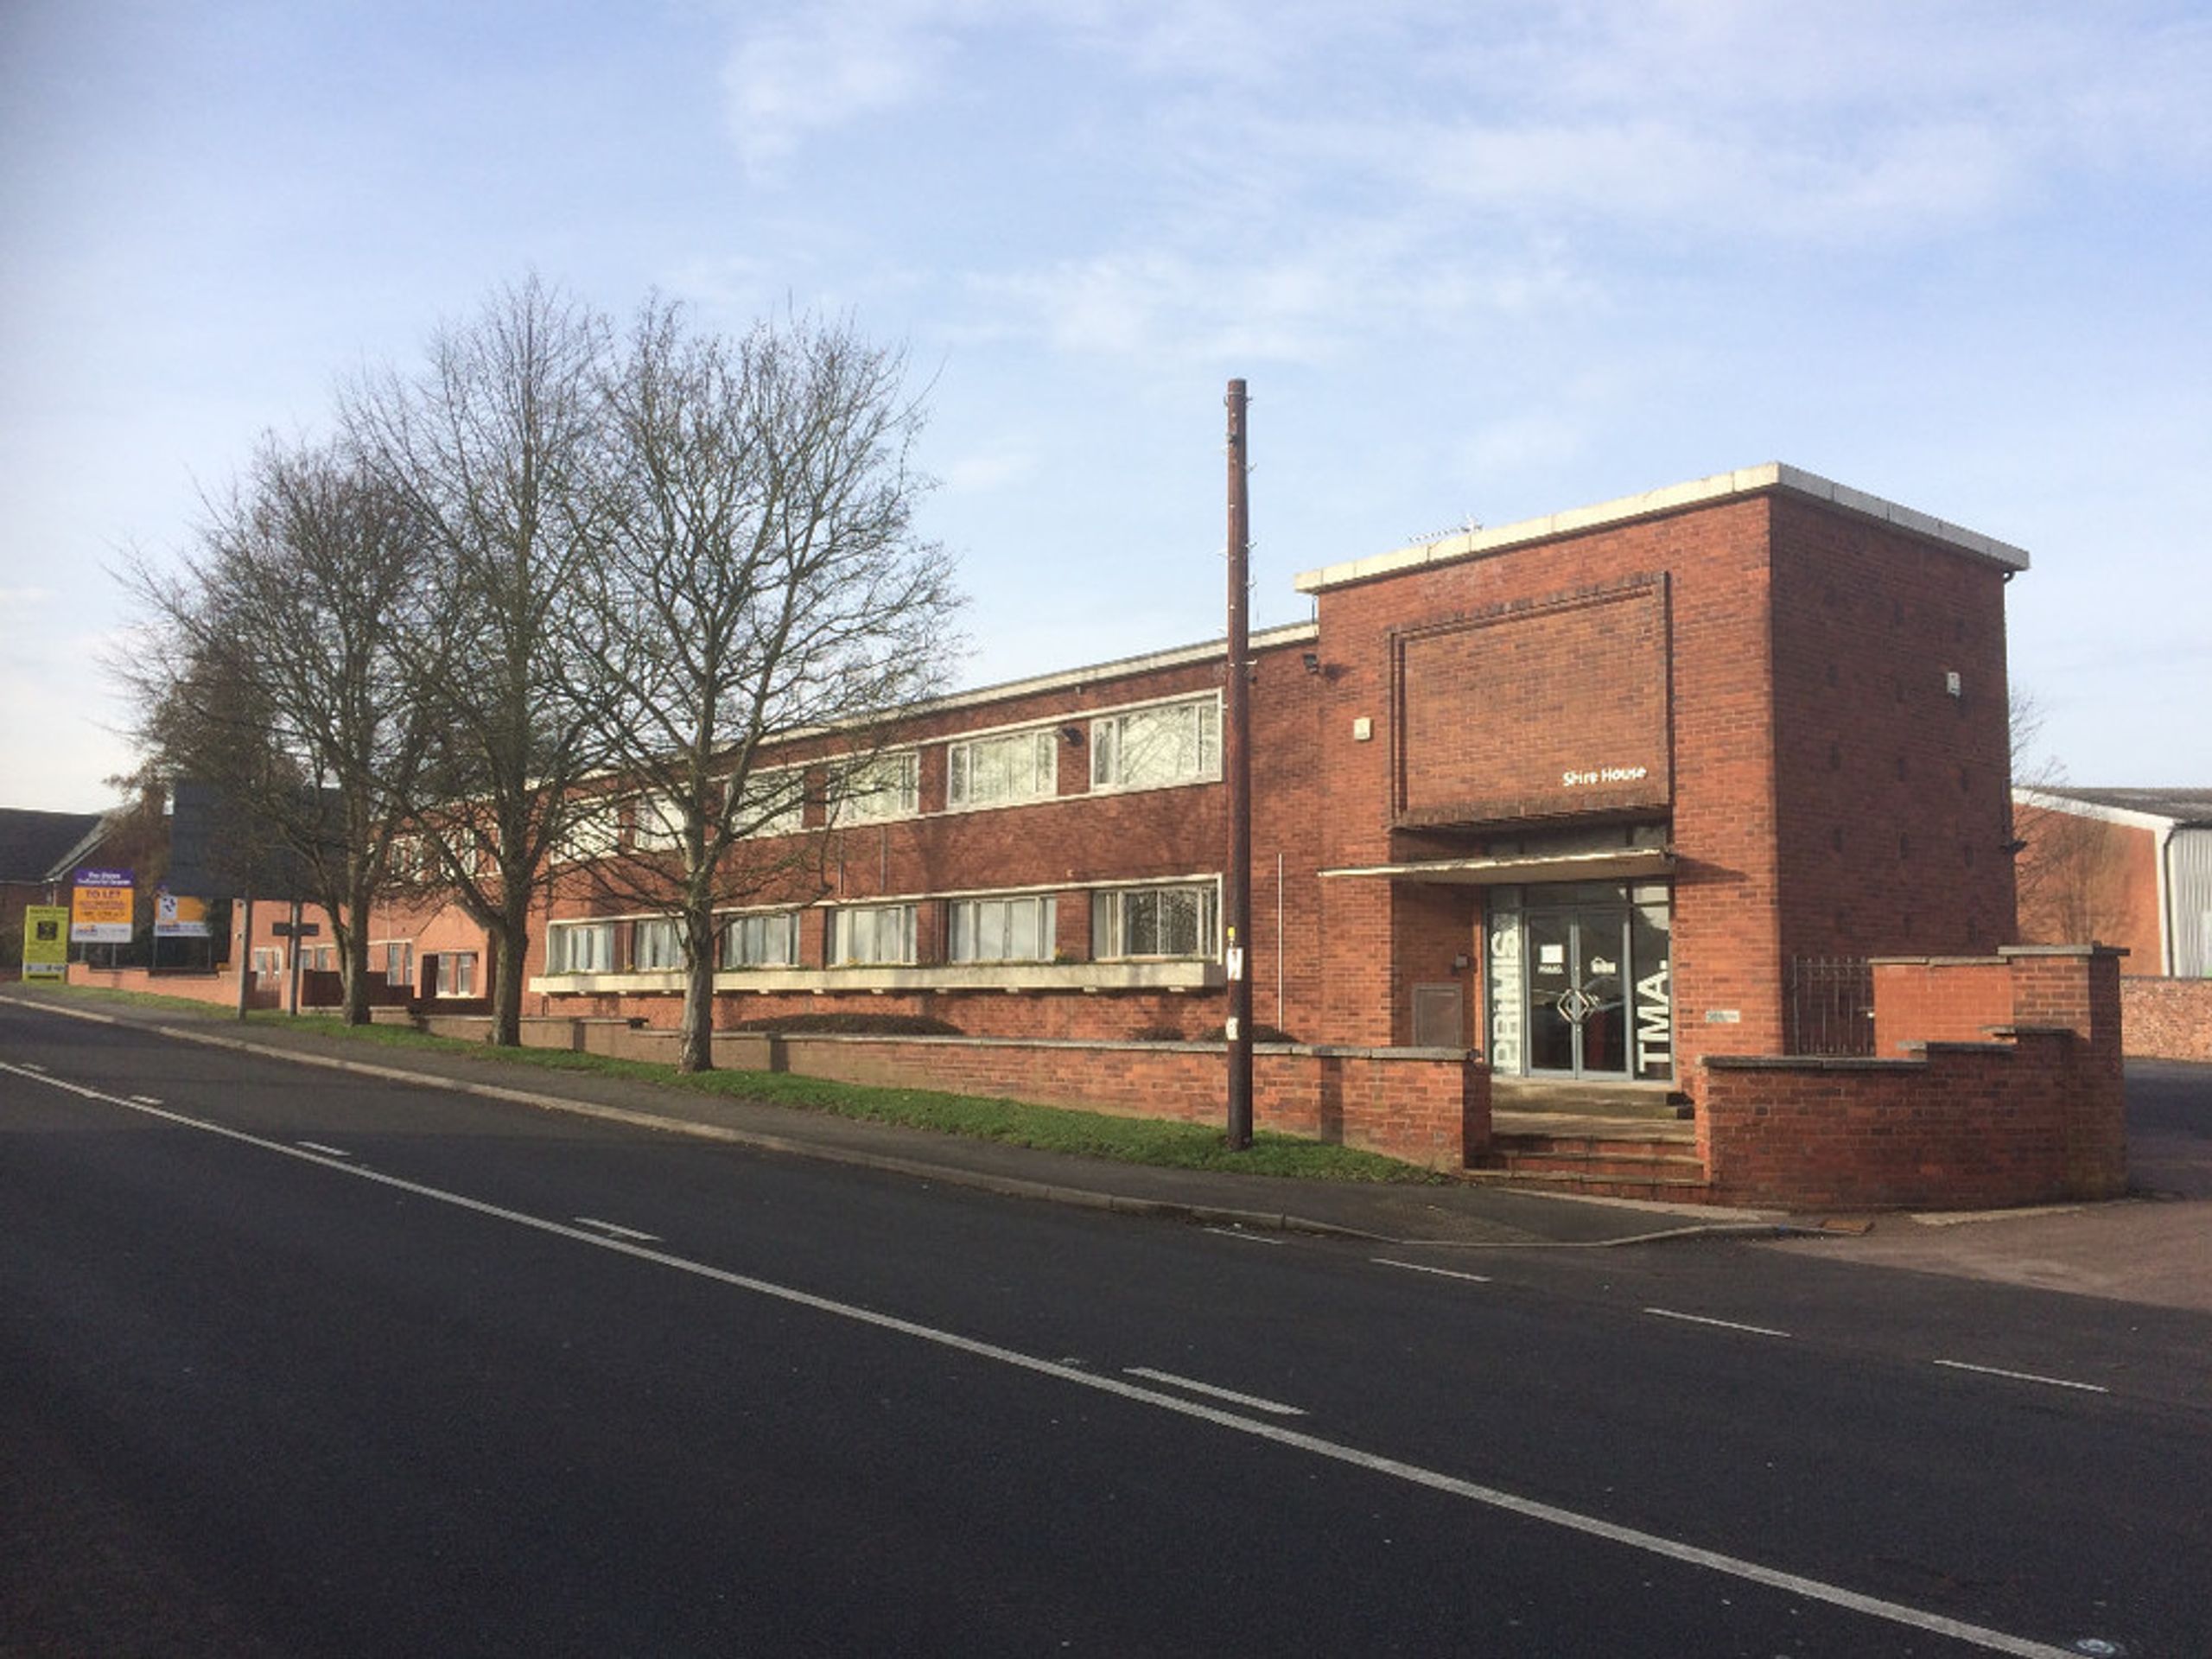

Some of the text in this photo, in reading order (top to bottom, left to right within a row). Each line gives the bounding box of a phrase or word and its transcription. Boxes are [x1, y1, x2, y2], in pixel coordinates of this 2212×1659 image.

[1562, 766, 1647, 786] Shire House
[86, 890, 122, 899] TO LET
